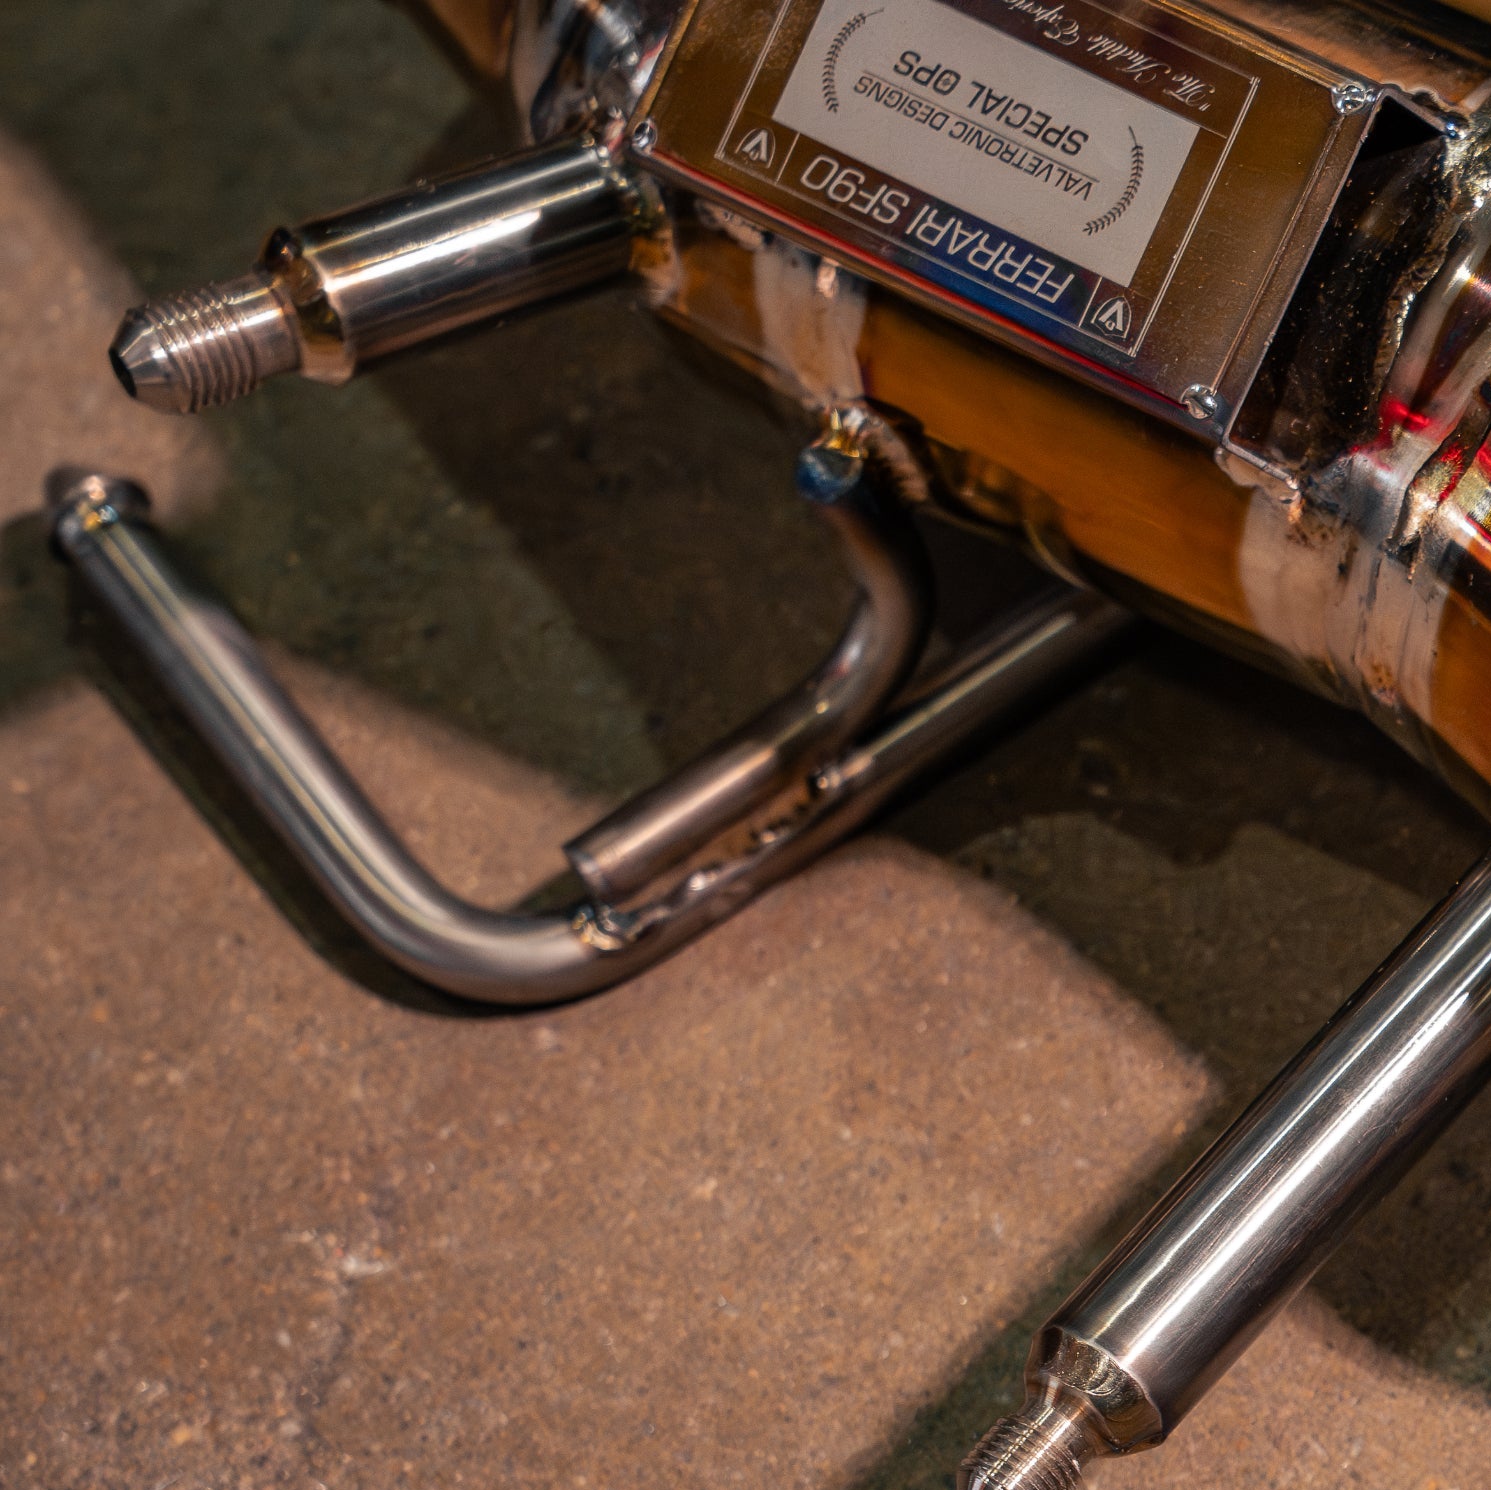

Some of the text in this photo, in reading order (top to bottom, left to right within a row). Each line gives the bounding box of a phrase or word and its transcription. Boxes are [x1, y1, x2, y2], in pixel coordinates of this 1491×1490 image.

[893, 50, 1089, 156] SPECIAL OPS
[1088, 34, 1171, 84] Audible
[853, 75, 1093, 201] VALVETRONIC DESIGNS
[800, 154, 1075, 304] FERRARI SF90
